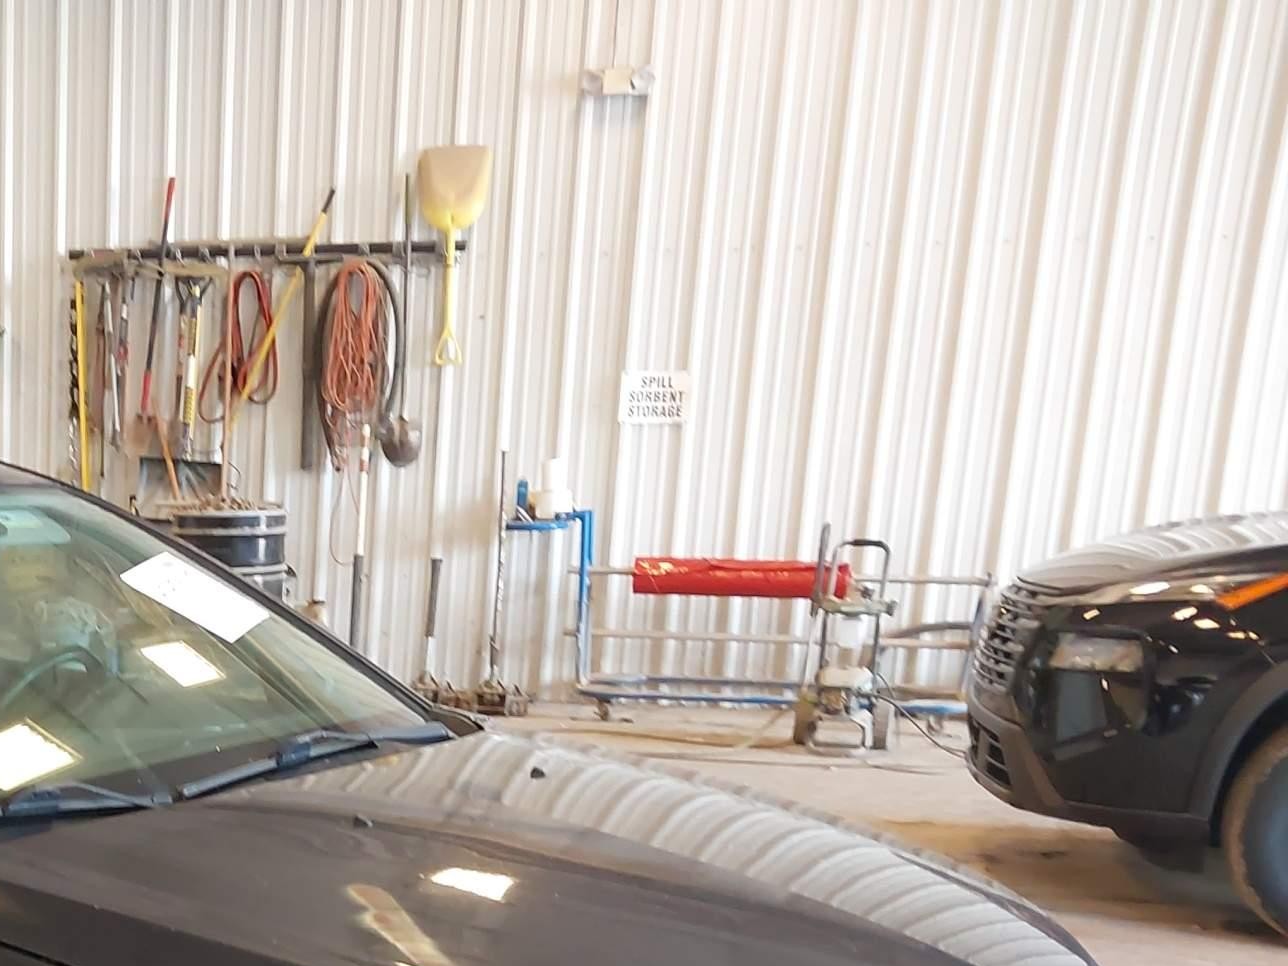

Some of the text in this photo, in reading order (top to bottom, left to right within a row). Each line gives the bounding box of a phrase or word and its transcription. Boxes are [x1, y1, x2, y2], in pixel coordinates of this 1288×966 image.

[640, 375, 674, 389] SPILL
[628, 390, 684, 403] SORBENT
[627, 405, 683, 418] STORAGE
